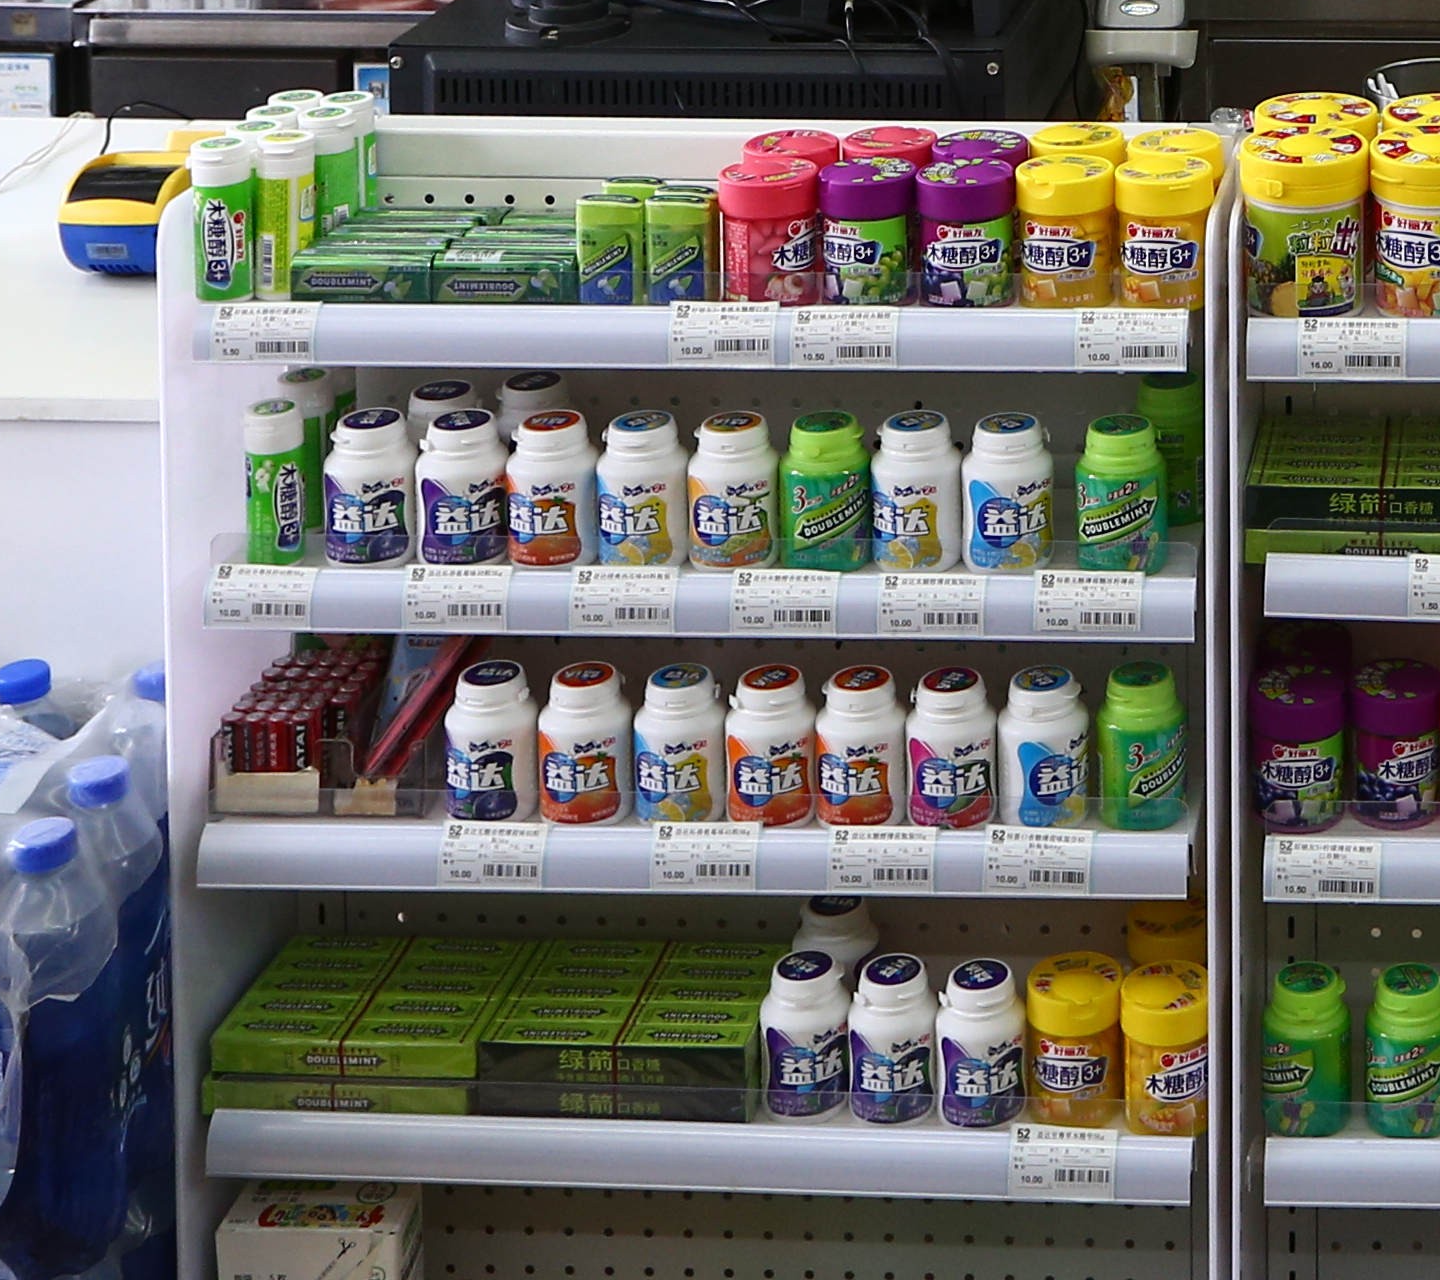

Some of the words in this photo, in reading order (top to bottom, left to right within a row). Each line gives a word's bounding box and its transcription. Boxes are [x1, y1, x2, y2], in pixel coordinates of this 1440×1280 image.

[1310, 361, 1333, 370] 16.00
[331, 502, 399, 535] 益达
[983, 503, 1048, 537] 益达
[1329, 492, 1387, 514] 绿箭
[1389, 498, 1434, 516] 口香糖
[545, 759, 610, 793] 益达
[779, 1057, 844, 1091] 益达
